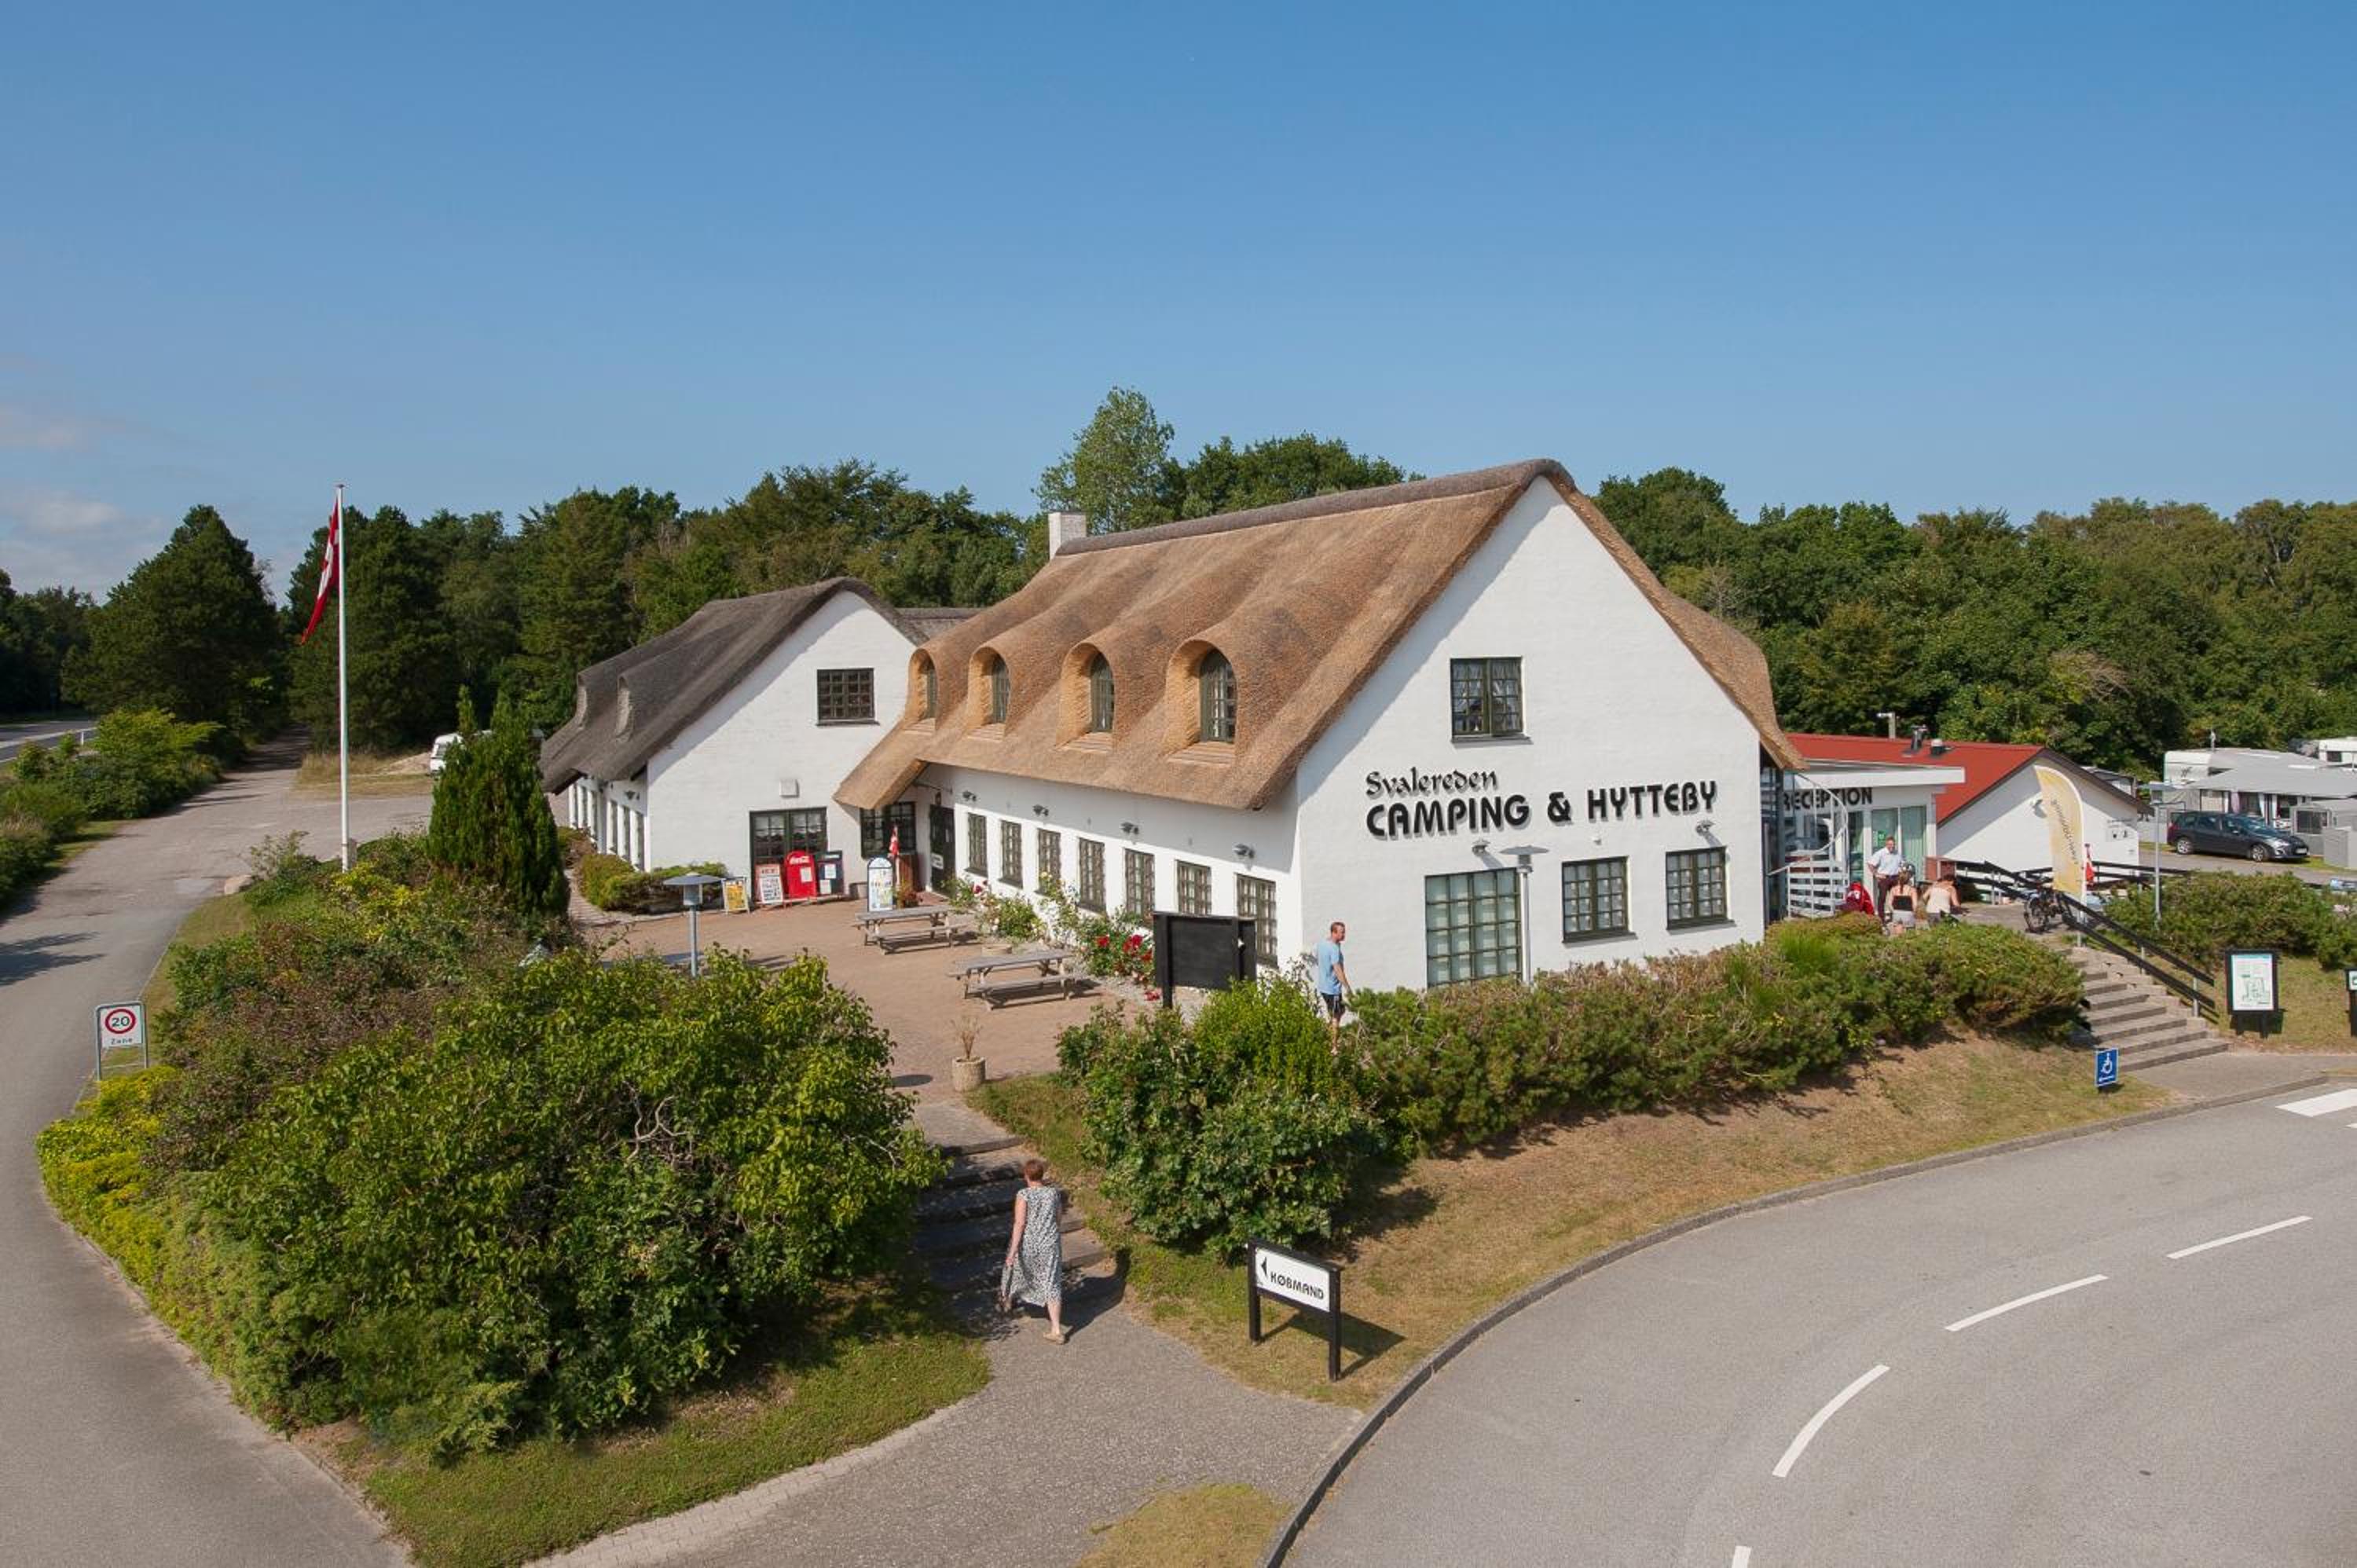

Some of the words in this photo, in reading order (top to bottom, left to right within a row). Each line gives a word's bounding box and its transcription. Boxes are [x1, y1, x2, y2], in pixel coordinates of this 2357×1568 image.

[1365, 767, 1497, 795] Svalereden
[1366, 795, 1530, 837] CAMPING
[1547, 792, 1571, 822] &
[1587, 781, 1717, 819] HYTTEBY
[112, 1017, 130, 1027] 20
[1270, 1271, 1324, 1300] KØBMAND
